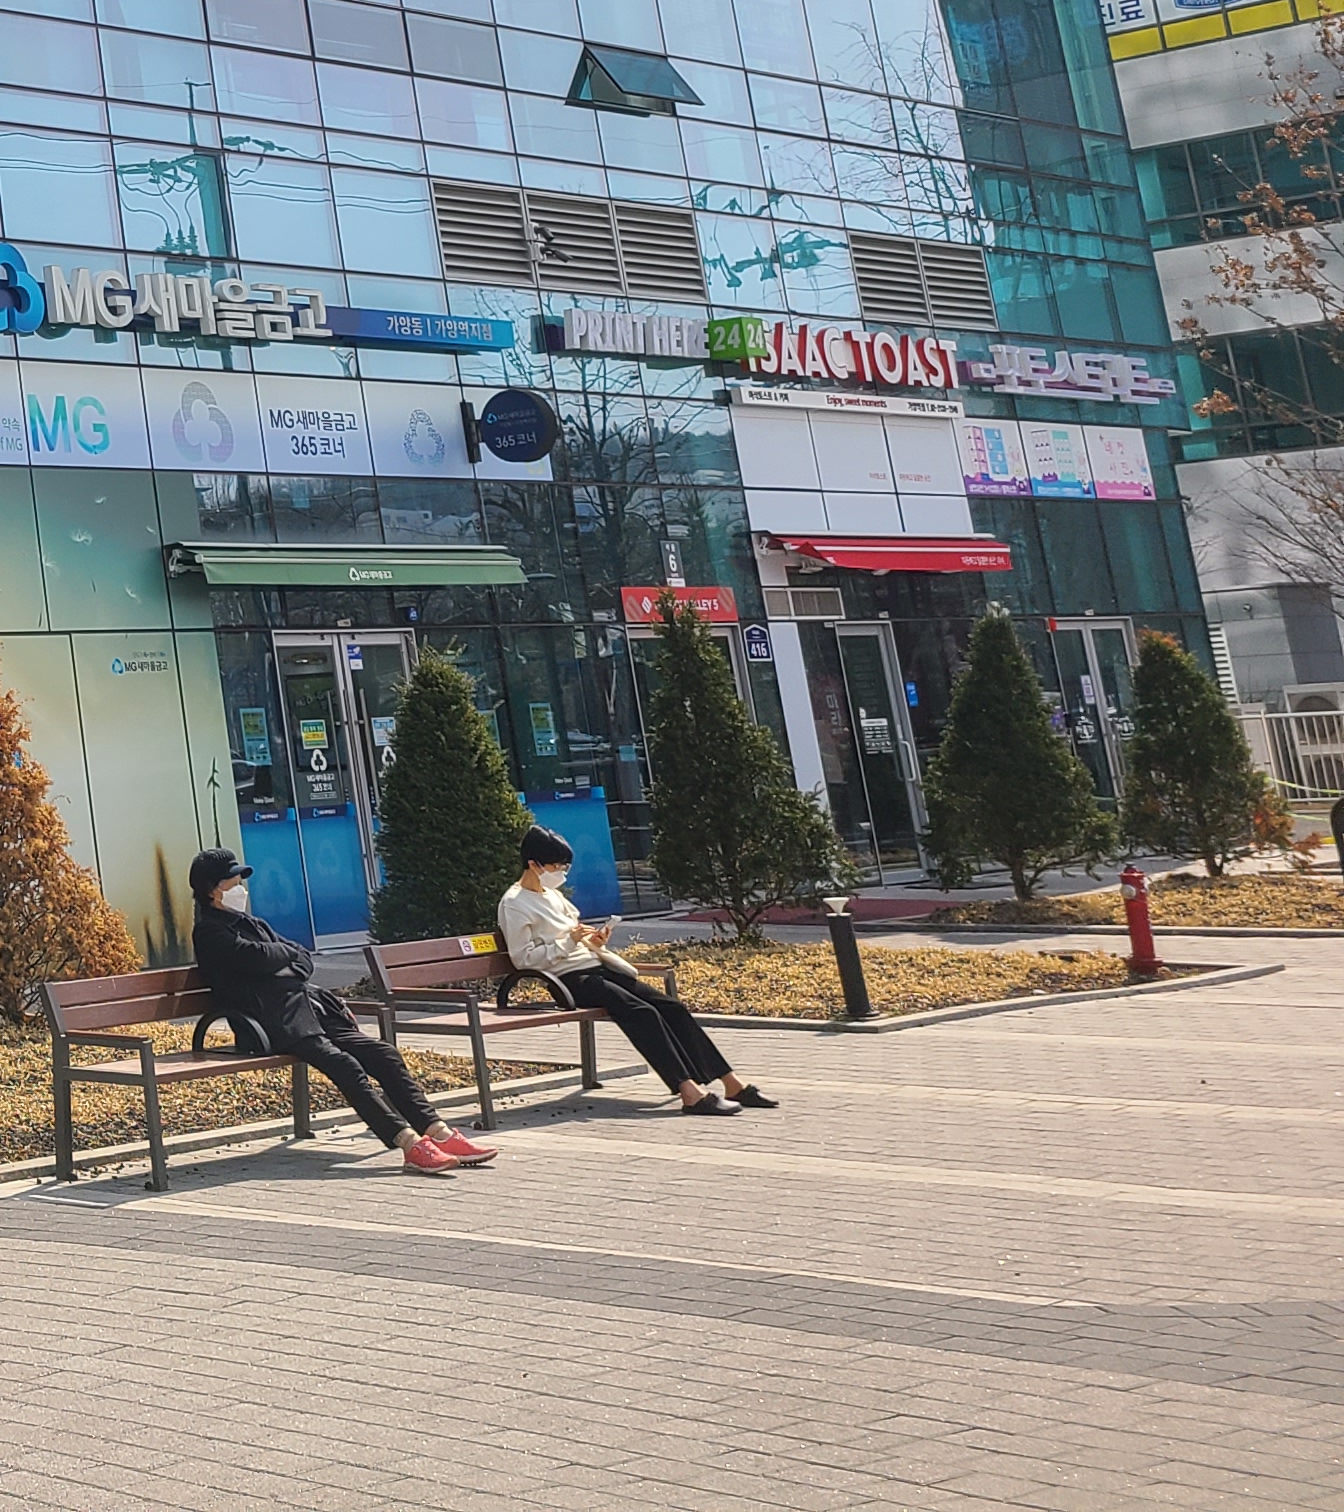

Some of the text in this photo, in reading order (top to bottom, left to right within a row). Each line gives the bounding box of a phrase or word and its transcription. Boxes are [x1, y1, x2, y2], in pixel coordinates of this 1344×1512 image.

[42, 264, 333, 343] MG새마을금고
[386, 315, 494, 341] 가양동 가양역지점
[565, 307, 648, 355] PRINT
[712, 323, 740, 352] 24
[844, 329, 960, 389] TOAST
[1, 416, 21, 432] 약속
[26, 393, 111, 455] MG
[268, 408, 359, 432] MG새마을금고
[6, 437, 23, 452] MG
[750, 642, 768, 658] 416
